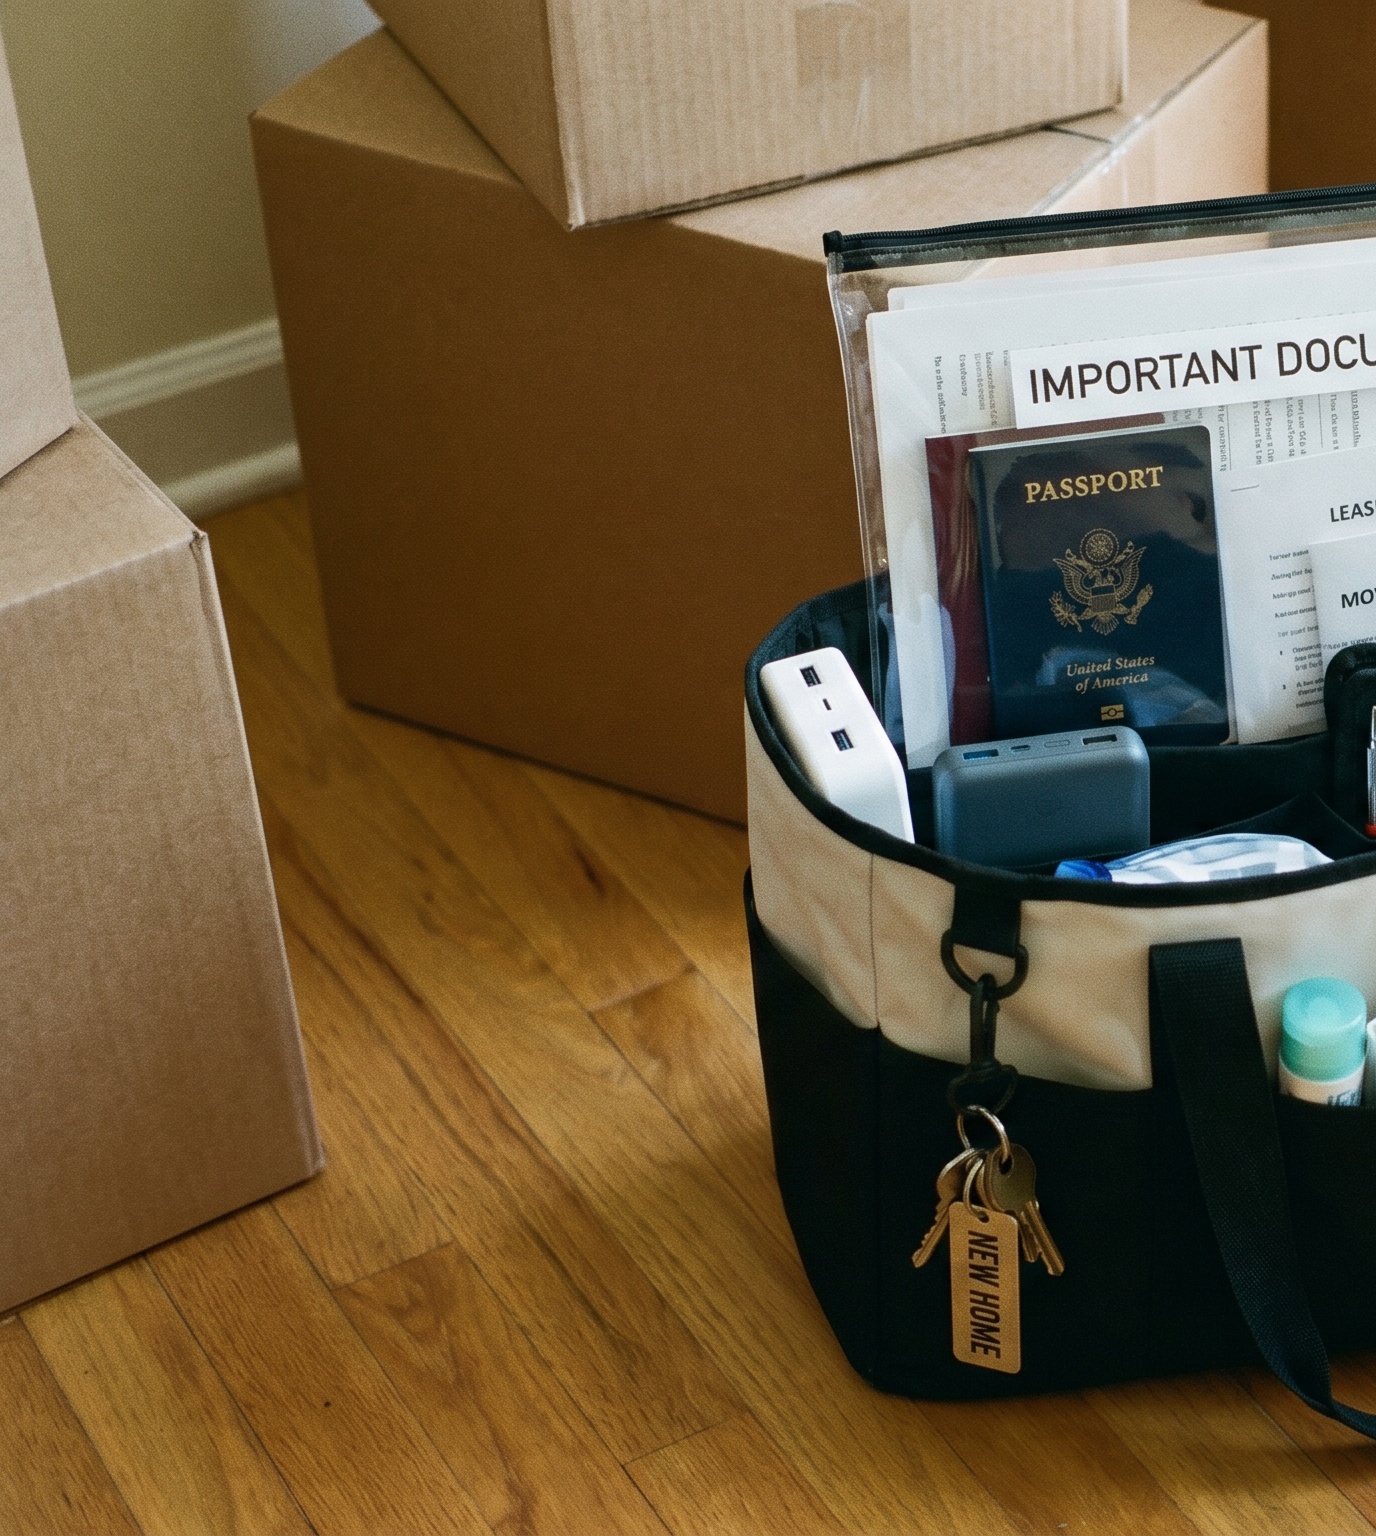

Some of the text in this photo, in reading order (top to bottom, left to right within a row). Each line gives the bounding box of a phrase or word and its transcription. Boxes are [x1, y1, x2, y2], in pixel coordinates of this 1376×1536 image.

[1029, 344, 1262, 404] IMPORTANT
[1024, 465, 1164, 504] PASSPORT
[1066, 656, 1155, 677] United States
[1075, 678, 1090, 695] of
[967, 1229, 1001, 1360] NEW HOME
